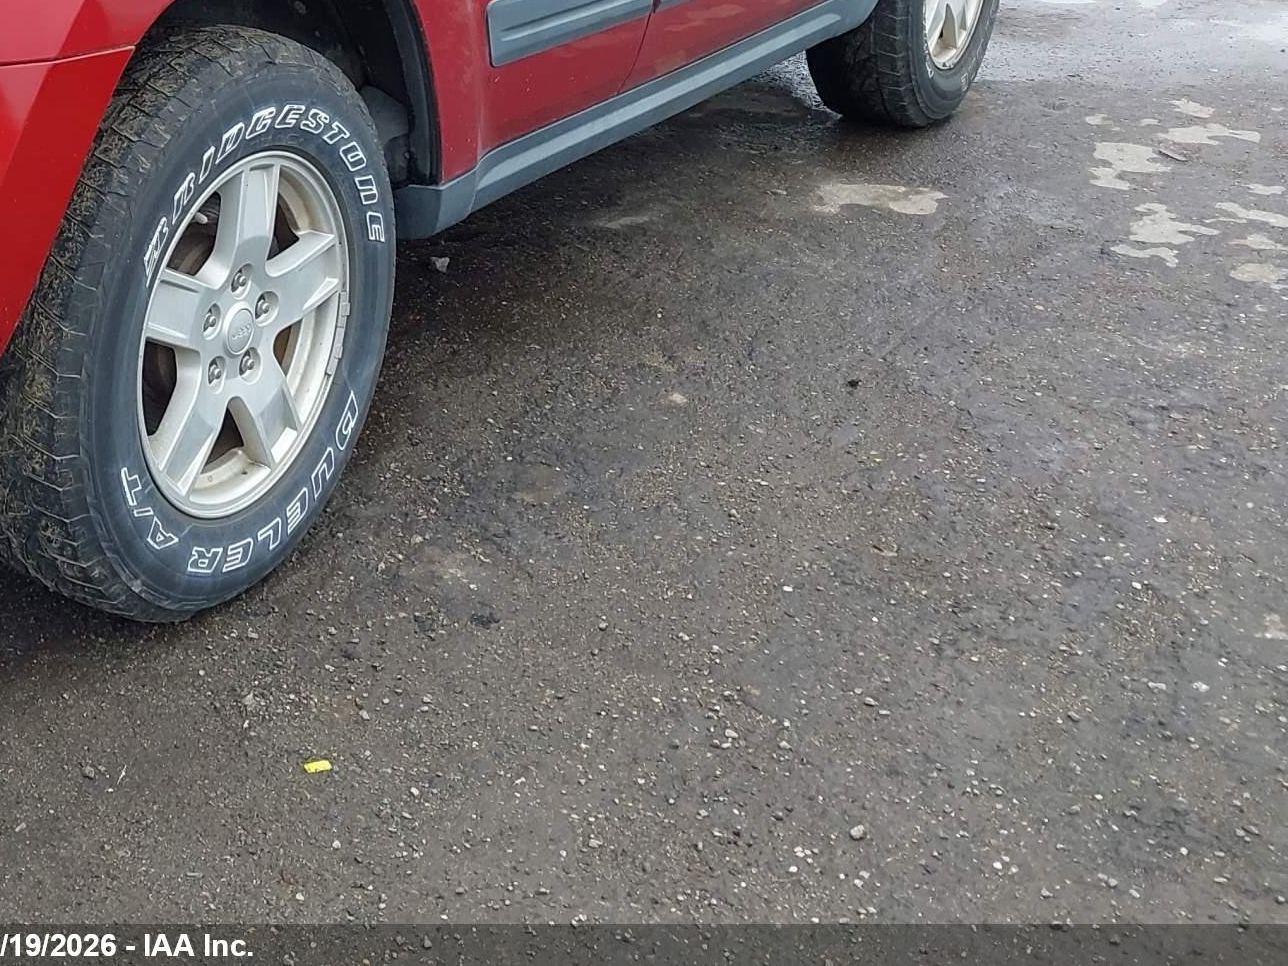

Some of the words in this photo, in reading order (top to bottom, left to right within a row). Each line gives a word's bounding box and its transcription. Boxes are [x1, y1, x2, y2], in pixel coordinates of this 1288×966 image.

[143, 103, 386, 288] BRIDGESTONE
[120, 466, 179, 550] A/T
[186, 390, 359, 573] DUELER
